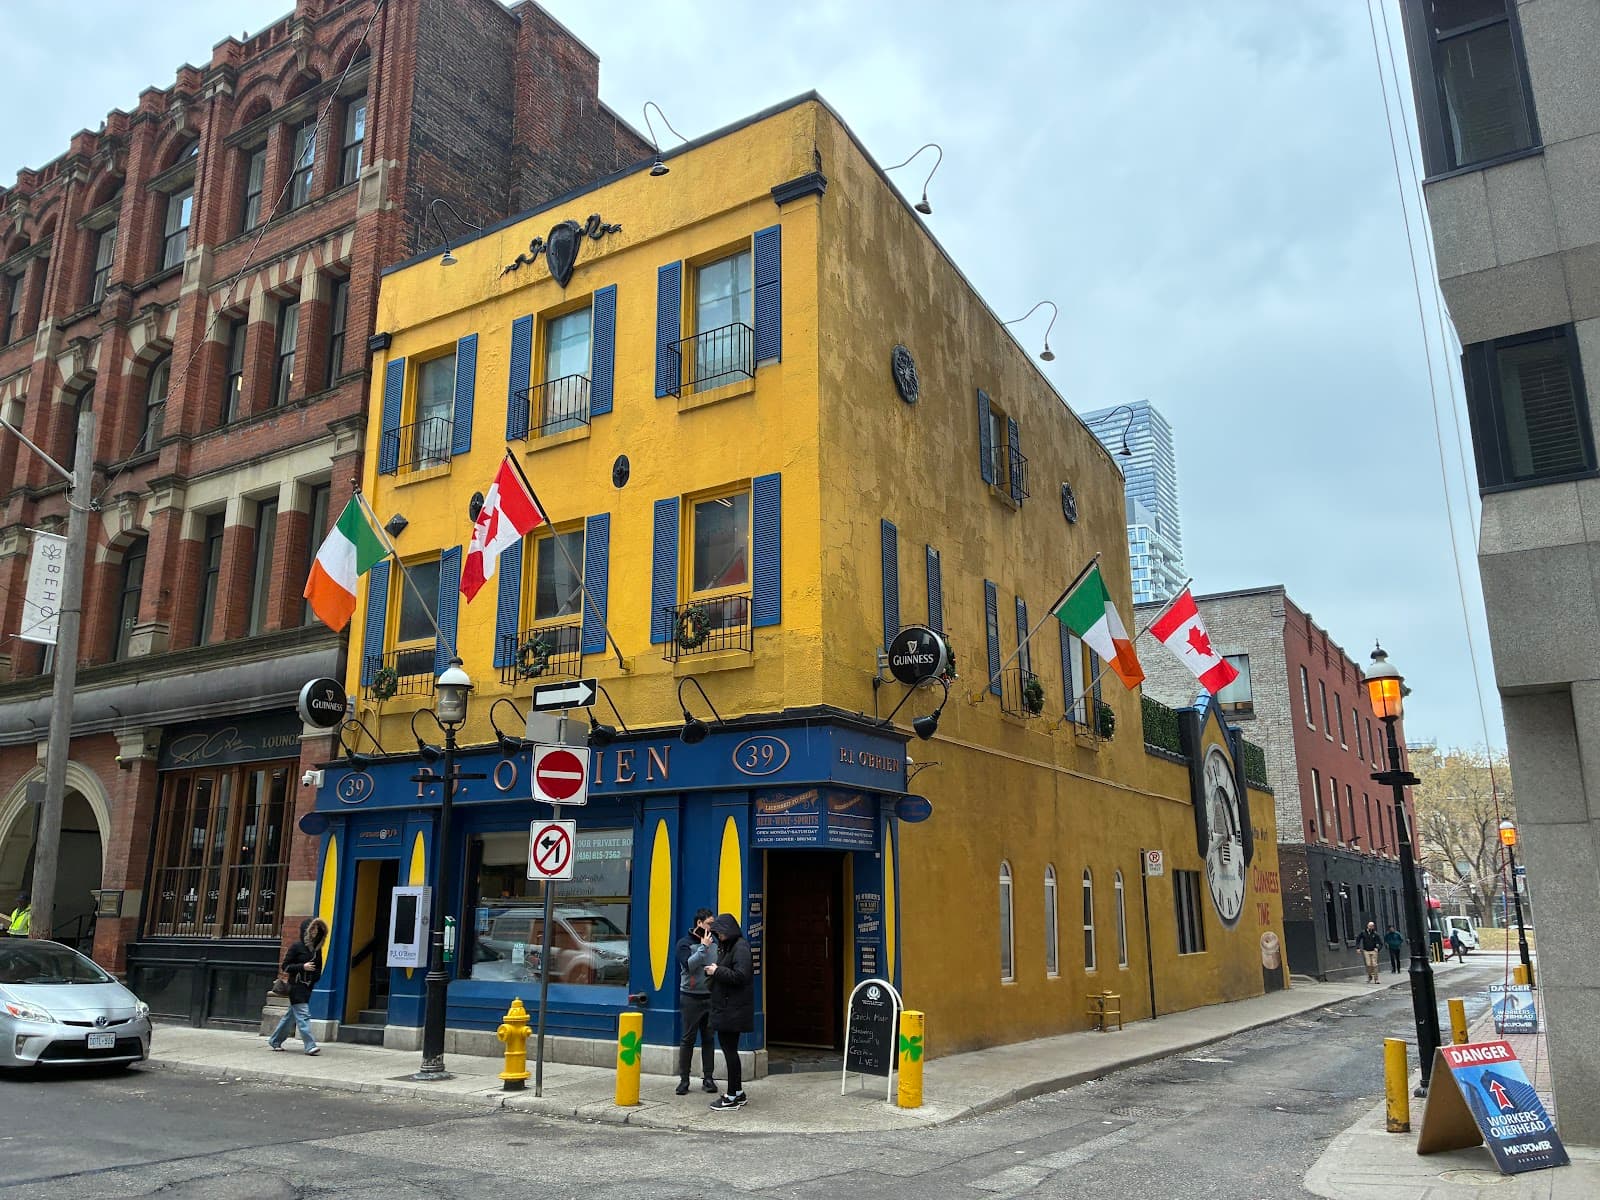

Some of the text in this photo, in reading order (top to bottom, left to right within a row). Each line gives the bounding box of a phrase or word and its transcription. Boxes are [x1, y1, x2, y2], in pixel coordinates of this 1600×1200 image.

[38, 564, 61, 635] BEHOT
[893, 654, 934, 666] GUINNESS
[311, 698, 343, 711] GUINNESS
[746, 745, 774, 767] 39
[493, 745, 672, 792] O'IEN
[345, 778, 365, 798] 39
[1253, 864, 1279, 894] GUINNESS
[1257, 902, 1270, 927] TIME
[1450, 1045, 1510, 1063] DANGER
[1486, 1110, 1539, 1126] WORKERS
[1490, 1120, 1546, 1138] OVERHEAD
[1503, 1140, 1552, 1156] MAXPOWER
